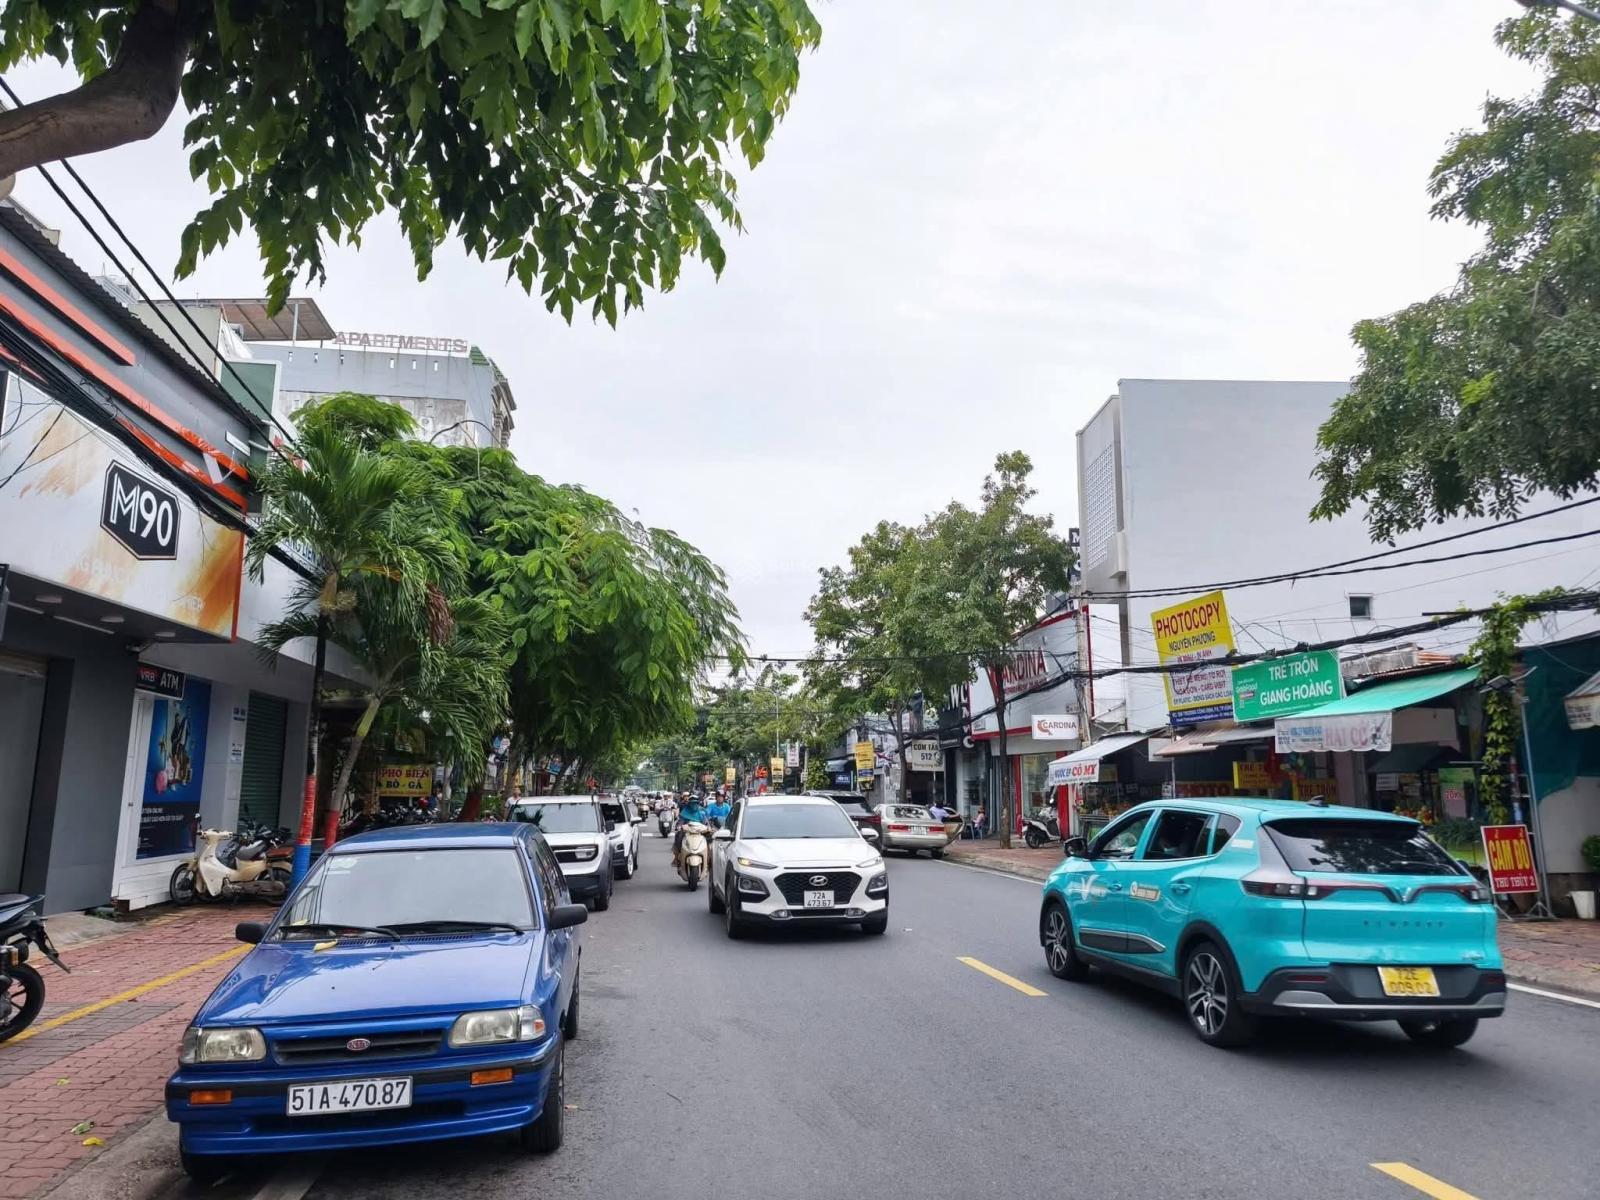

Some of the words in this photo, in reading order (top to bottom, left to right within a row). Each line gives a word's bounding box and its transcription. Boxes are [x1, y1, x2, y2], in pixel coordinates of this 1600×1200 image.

[334, 331, 468, 353] APARTMENTS
[110, 472, 173, 547] M90
[1156, 600, 1221, 639] PHOTOCOPY
[1001, 647, 1047, 685] ARDINA
[1289, 655, 1319, 678] TRỘN
[160, 671, 180, 689] ATM
[1260, 687, 1291, 706] GIANG
[1292, 678, 1334, 700] HOÀNG
[1043, 720, 1077, 729] CARDINA
[920, 752, 933, 761] 512
[1530, 876, 1535, 887] 2
[292, 1081, 408, 1111] 51A-470.87
